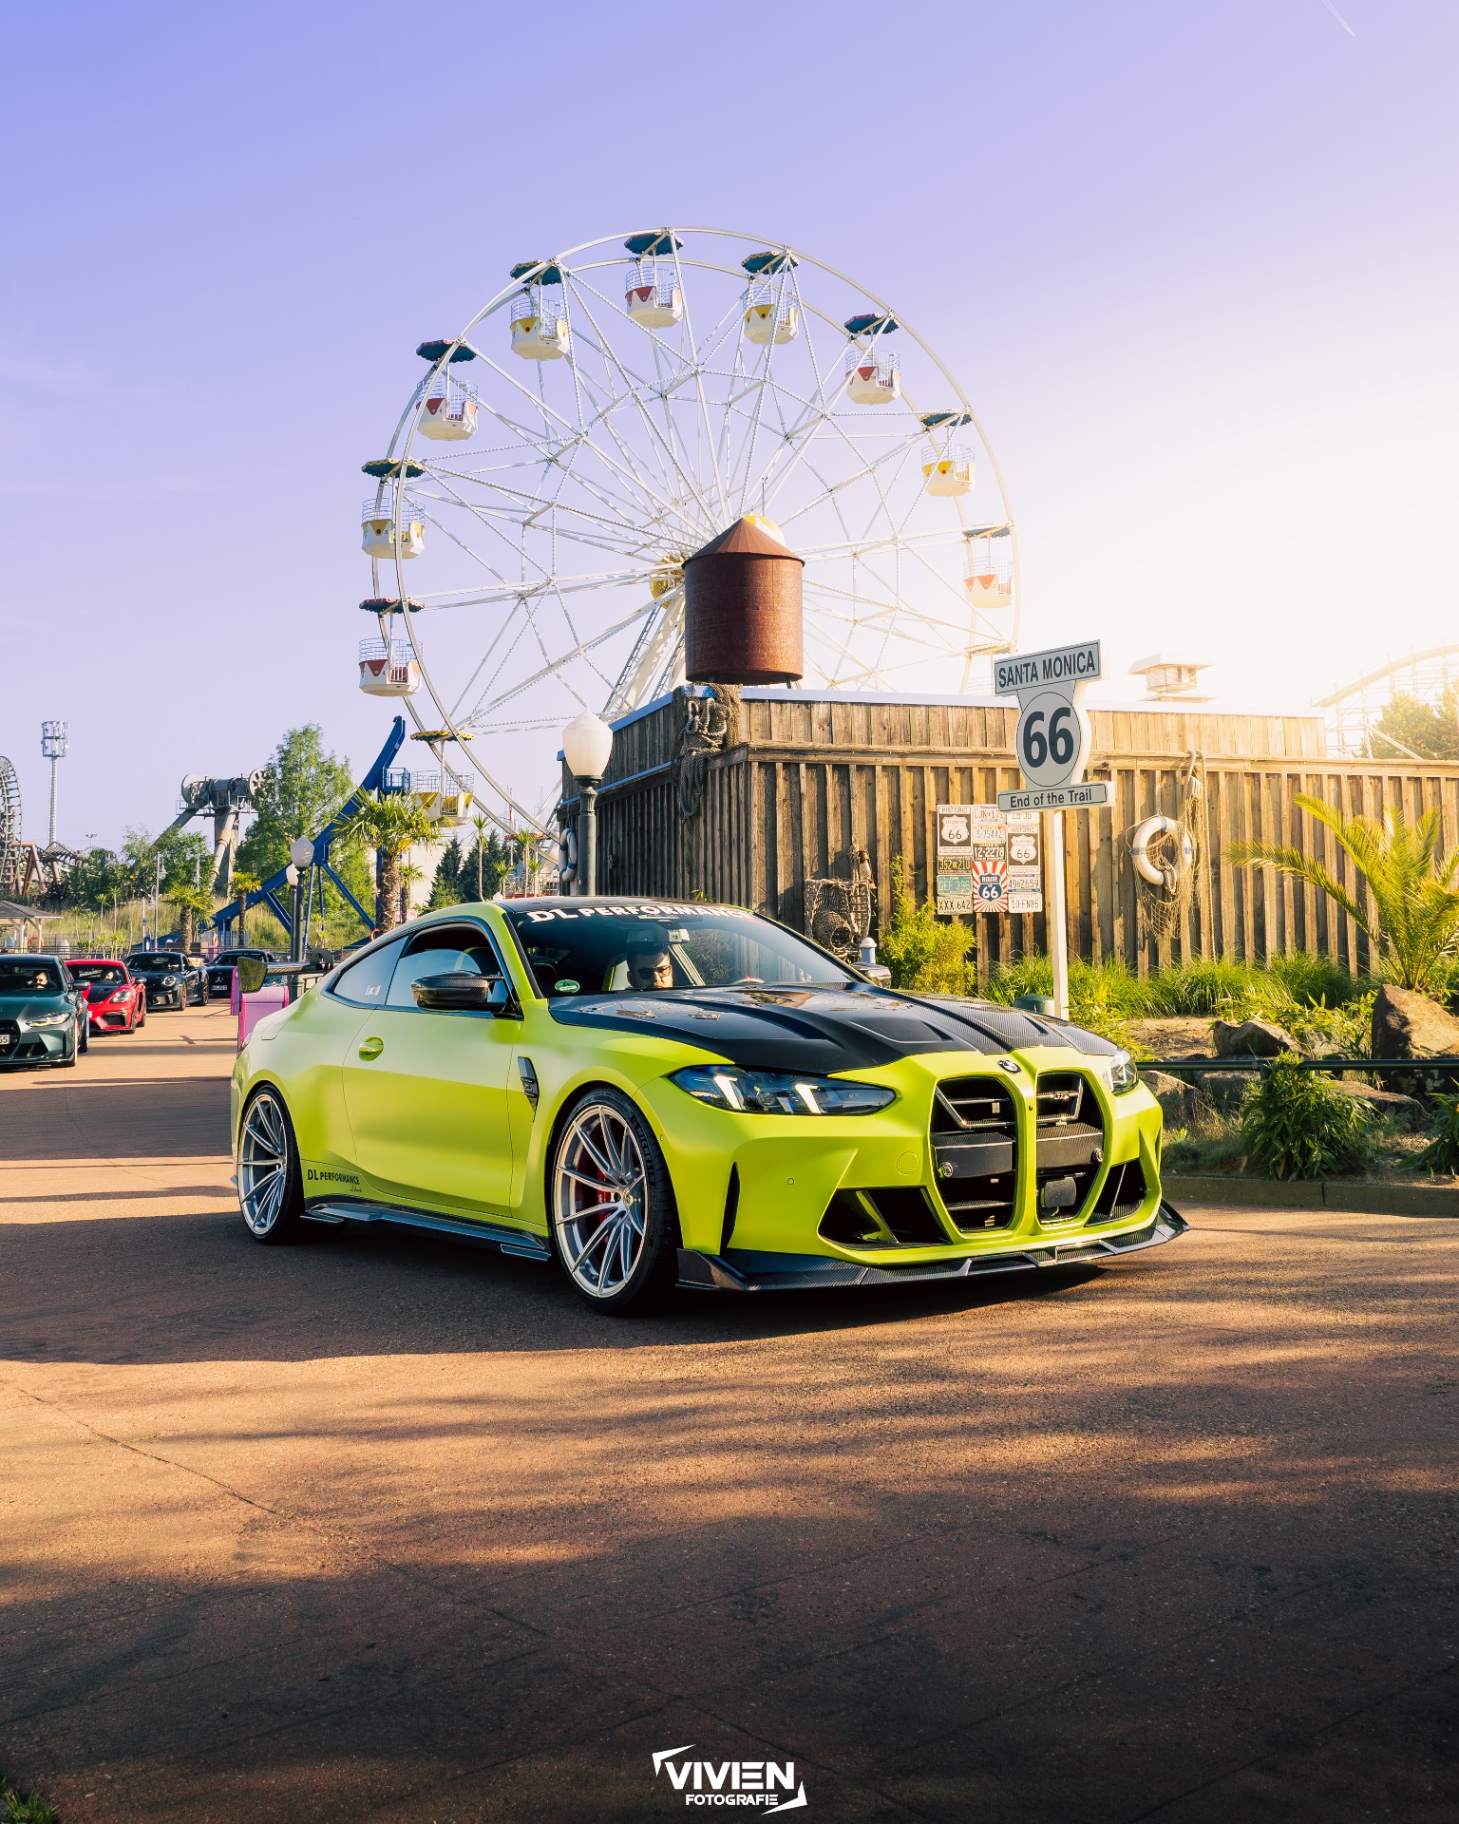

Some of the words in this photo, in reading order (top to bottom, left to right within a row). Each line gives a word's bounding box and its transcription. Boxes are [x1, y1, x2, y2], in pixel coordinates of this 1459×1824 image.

[998, 661, 1039, 688] SANTA
[1042, 650, 1096, 680] MONICA
[1022, 706, 1074, 768] 66
[1010, 795, 1030, 808] End
[1033, 793, 1044, 806] of
[1047, 791, 1065, 804] the
[1068, 788, 1092, 803] Trail
[948, 829, 962, 840] 66
[1016, 848, 1031, 859] 66
[982, 886, 999, 899] 66
[527, 907, 579, 923] DL
[307, 1169, 319, 1181] DL
[320, 1171, 360, 1185] PERFORMANCE
